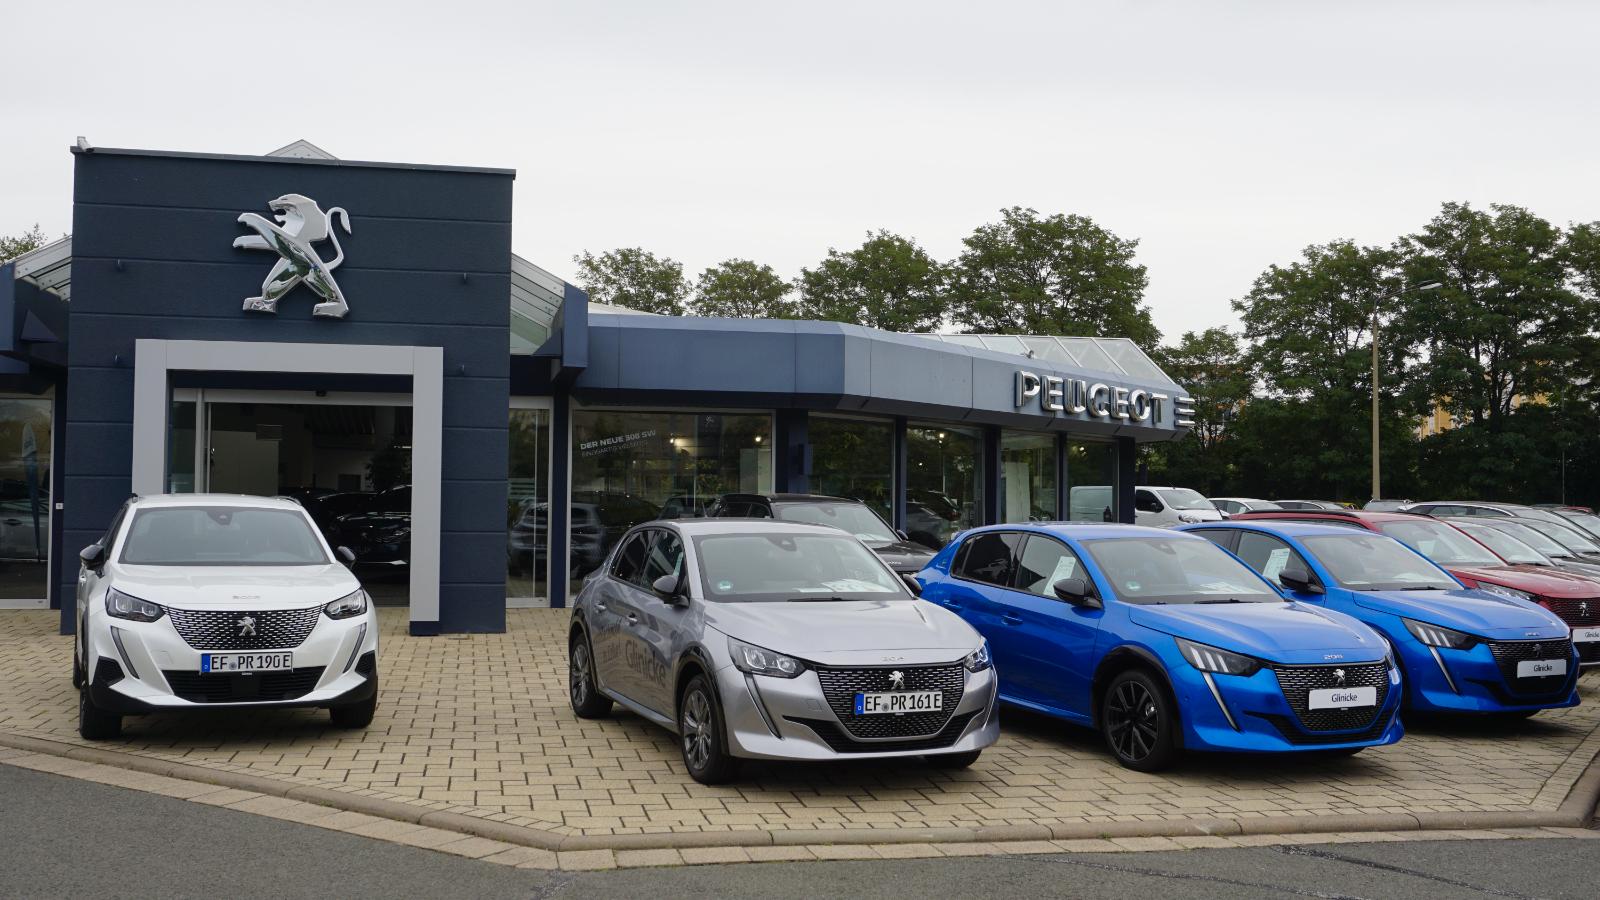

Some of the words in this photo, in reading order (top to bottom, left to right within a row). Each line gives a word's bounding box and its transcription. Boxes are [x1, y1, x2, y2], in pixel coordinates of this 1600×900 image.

[1015, 370, 1168, 424] PEUGEOT
[580, 440, 598, 450] DER
[600, 436, 624, 446] NEUE
[641, 430, 656, 438] SW
[211, 656, 228, 670] EF
[238, 655, 254, 669] PR
[865, 695, 882, 711] EF
[890, 694, 907, 710] PR
[1331, 693, 1358, 702] Glinicke
